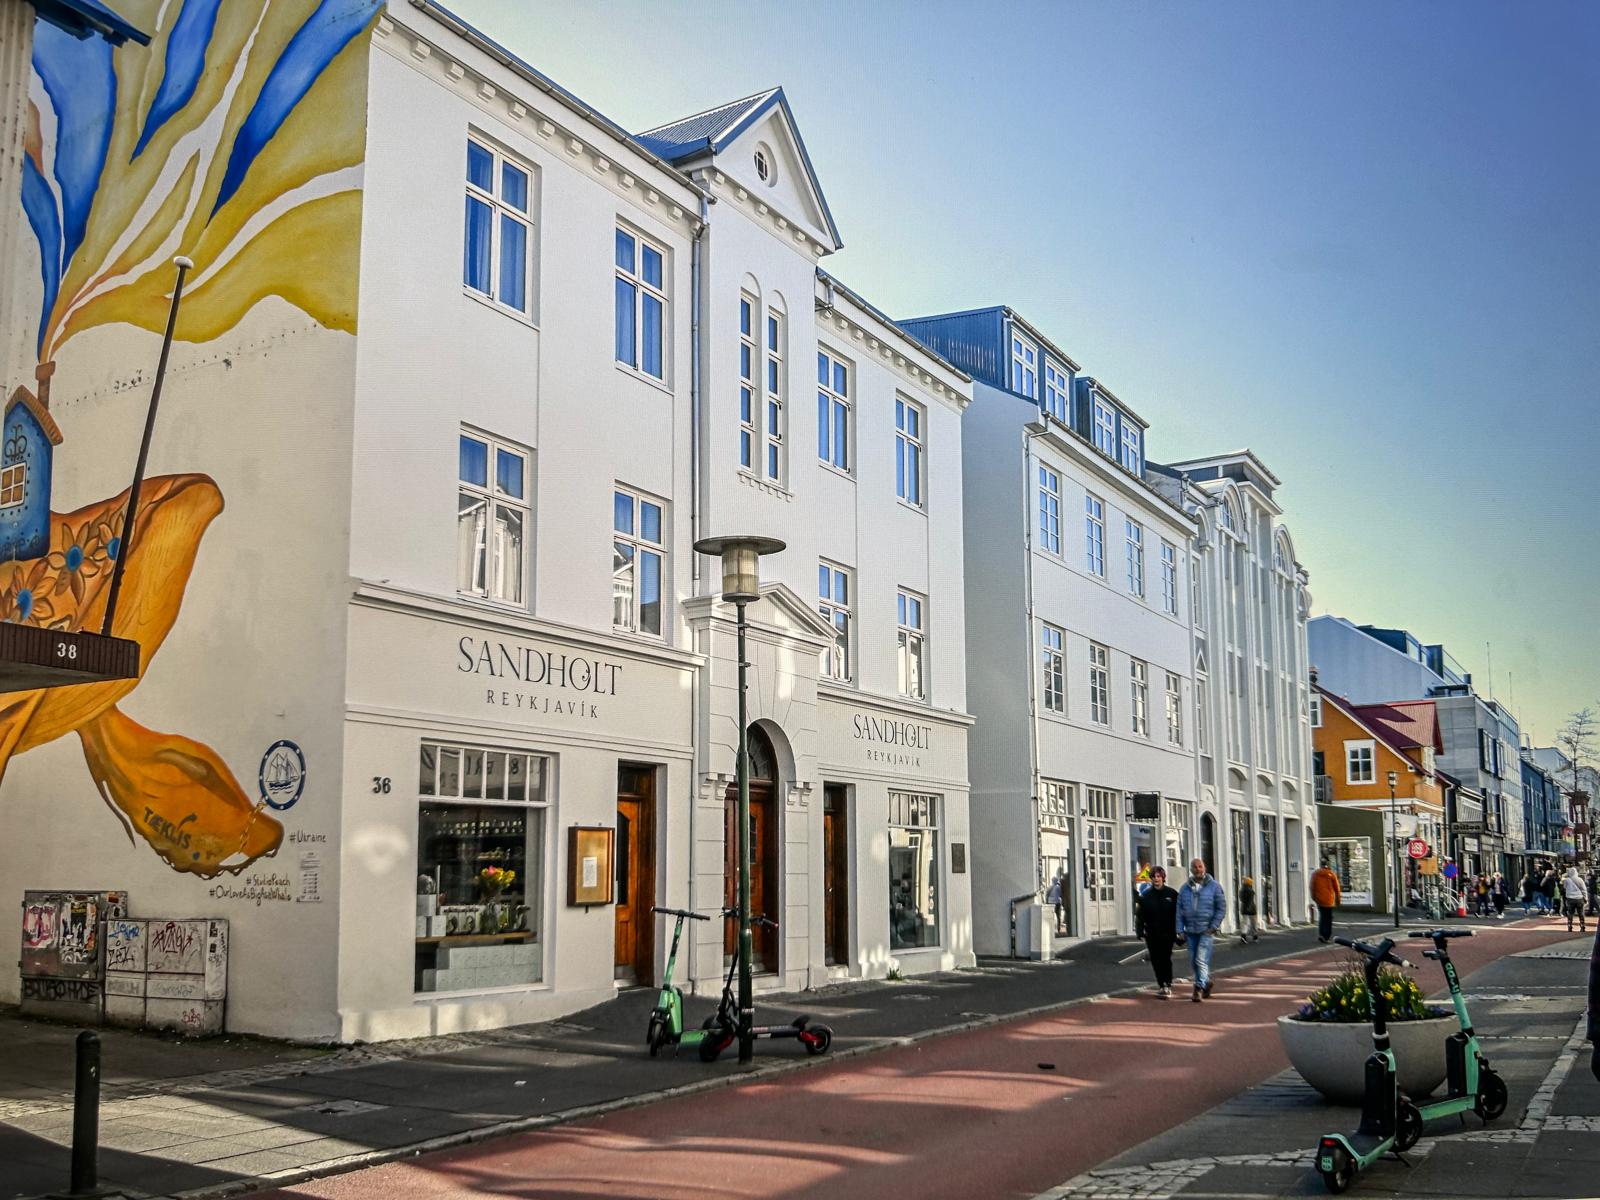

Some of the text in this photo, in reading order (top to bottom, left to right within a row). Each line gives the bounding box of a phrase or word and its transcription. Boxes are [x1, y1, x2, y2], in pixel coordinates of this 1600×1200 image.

[57, 642, 77, 659] 38
[457, 636, 623, 696] SANDHOLT
[486, 689, 598, 719] REYKJAVÍK
[853, 713, 932, 750] SANDHOLT
[372, 776, 392, 794] 36
[289, 829, 327, 843] #Ukraine
